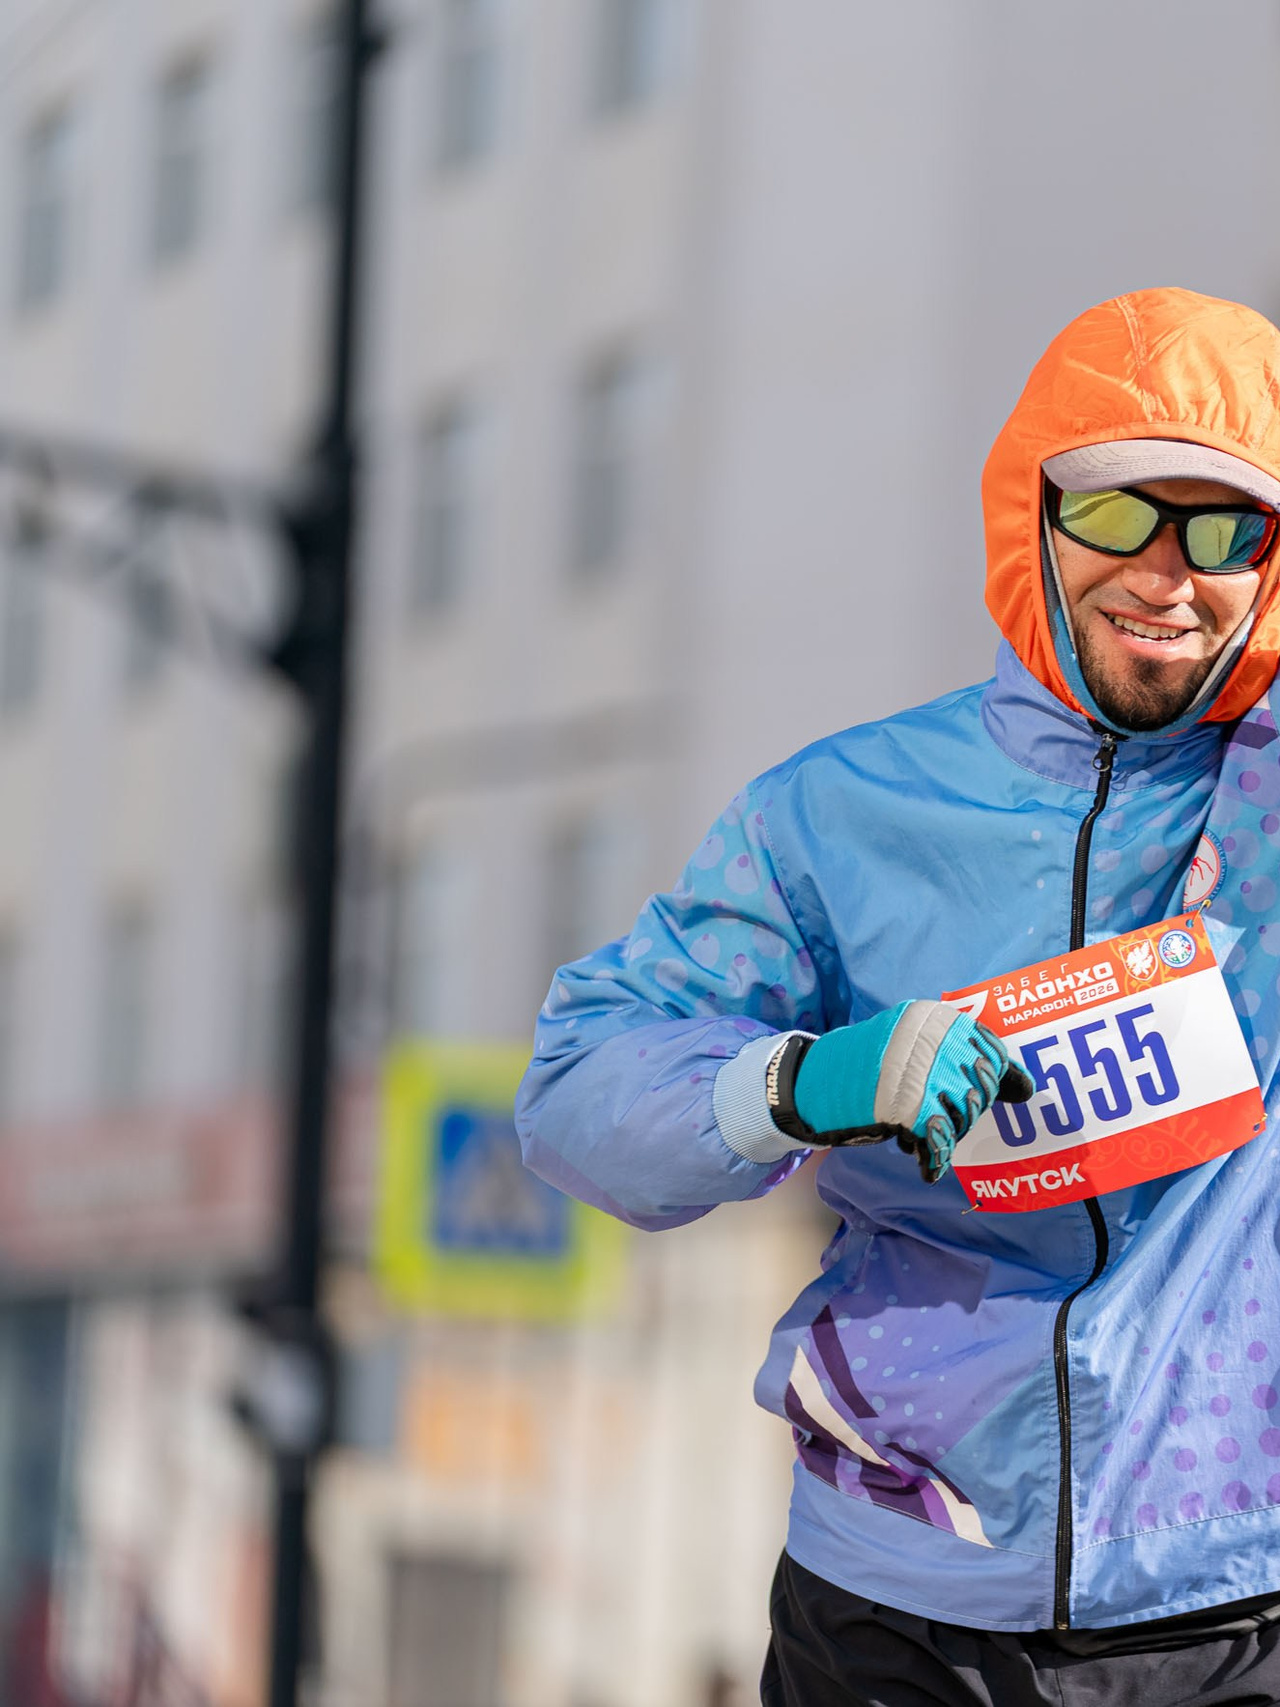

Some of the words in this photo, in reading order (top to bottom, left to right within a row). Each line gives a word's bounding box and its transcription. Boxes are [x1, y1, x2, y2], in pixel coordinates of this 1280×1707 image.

[993, 963, 1069, 997] ЗАБЕГ
[996, 961, 1114, 1013] ОЛОНХО
[1002, 995, 1075, 1027] МАРАФОН
[1080, 982, 1115, 1001] 2026
[970, 1162, 1086, 1199] ЯКУТСК
